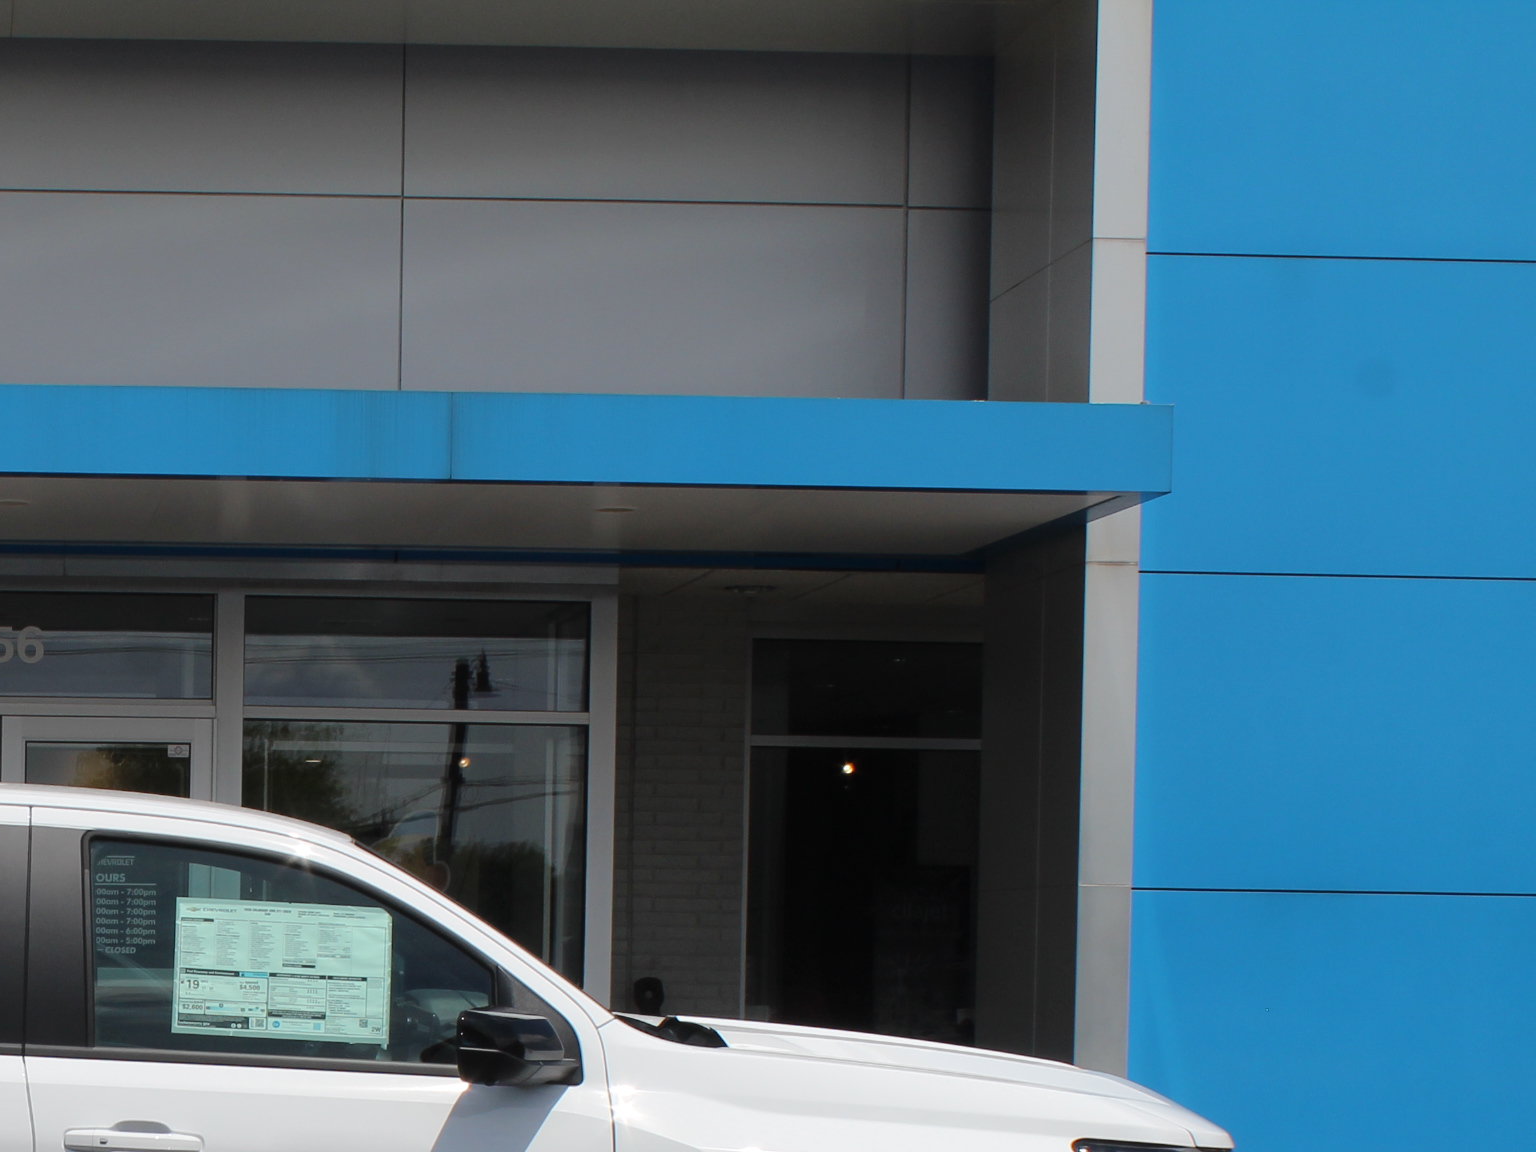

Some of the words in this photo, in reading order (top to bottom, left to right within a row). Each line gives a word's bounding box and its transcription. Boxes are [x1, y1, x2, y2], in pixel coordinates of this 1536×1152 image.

[126, 888, 156, 897] 7:00pm
[126, 898, 156, 906] 7:00pm
[126, 908, 156, 916] 7:00pm
[126, 917, 156, 926] 7:00pm
[126, 927, 156, 935] 6:00pm
[126, 937, 156, 945] 5:00pm
[104, 946, 136, 954] CLOSED
[186, 979, 200, 990] 19
[182, 1003, 203, 1011] $2,600
